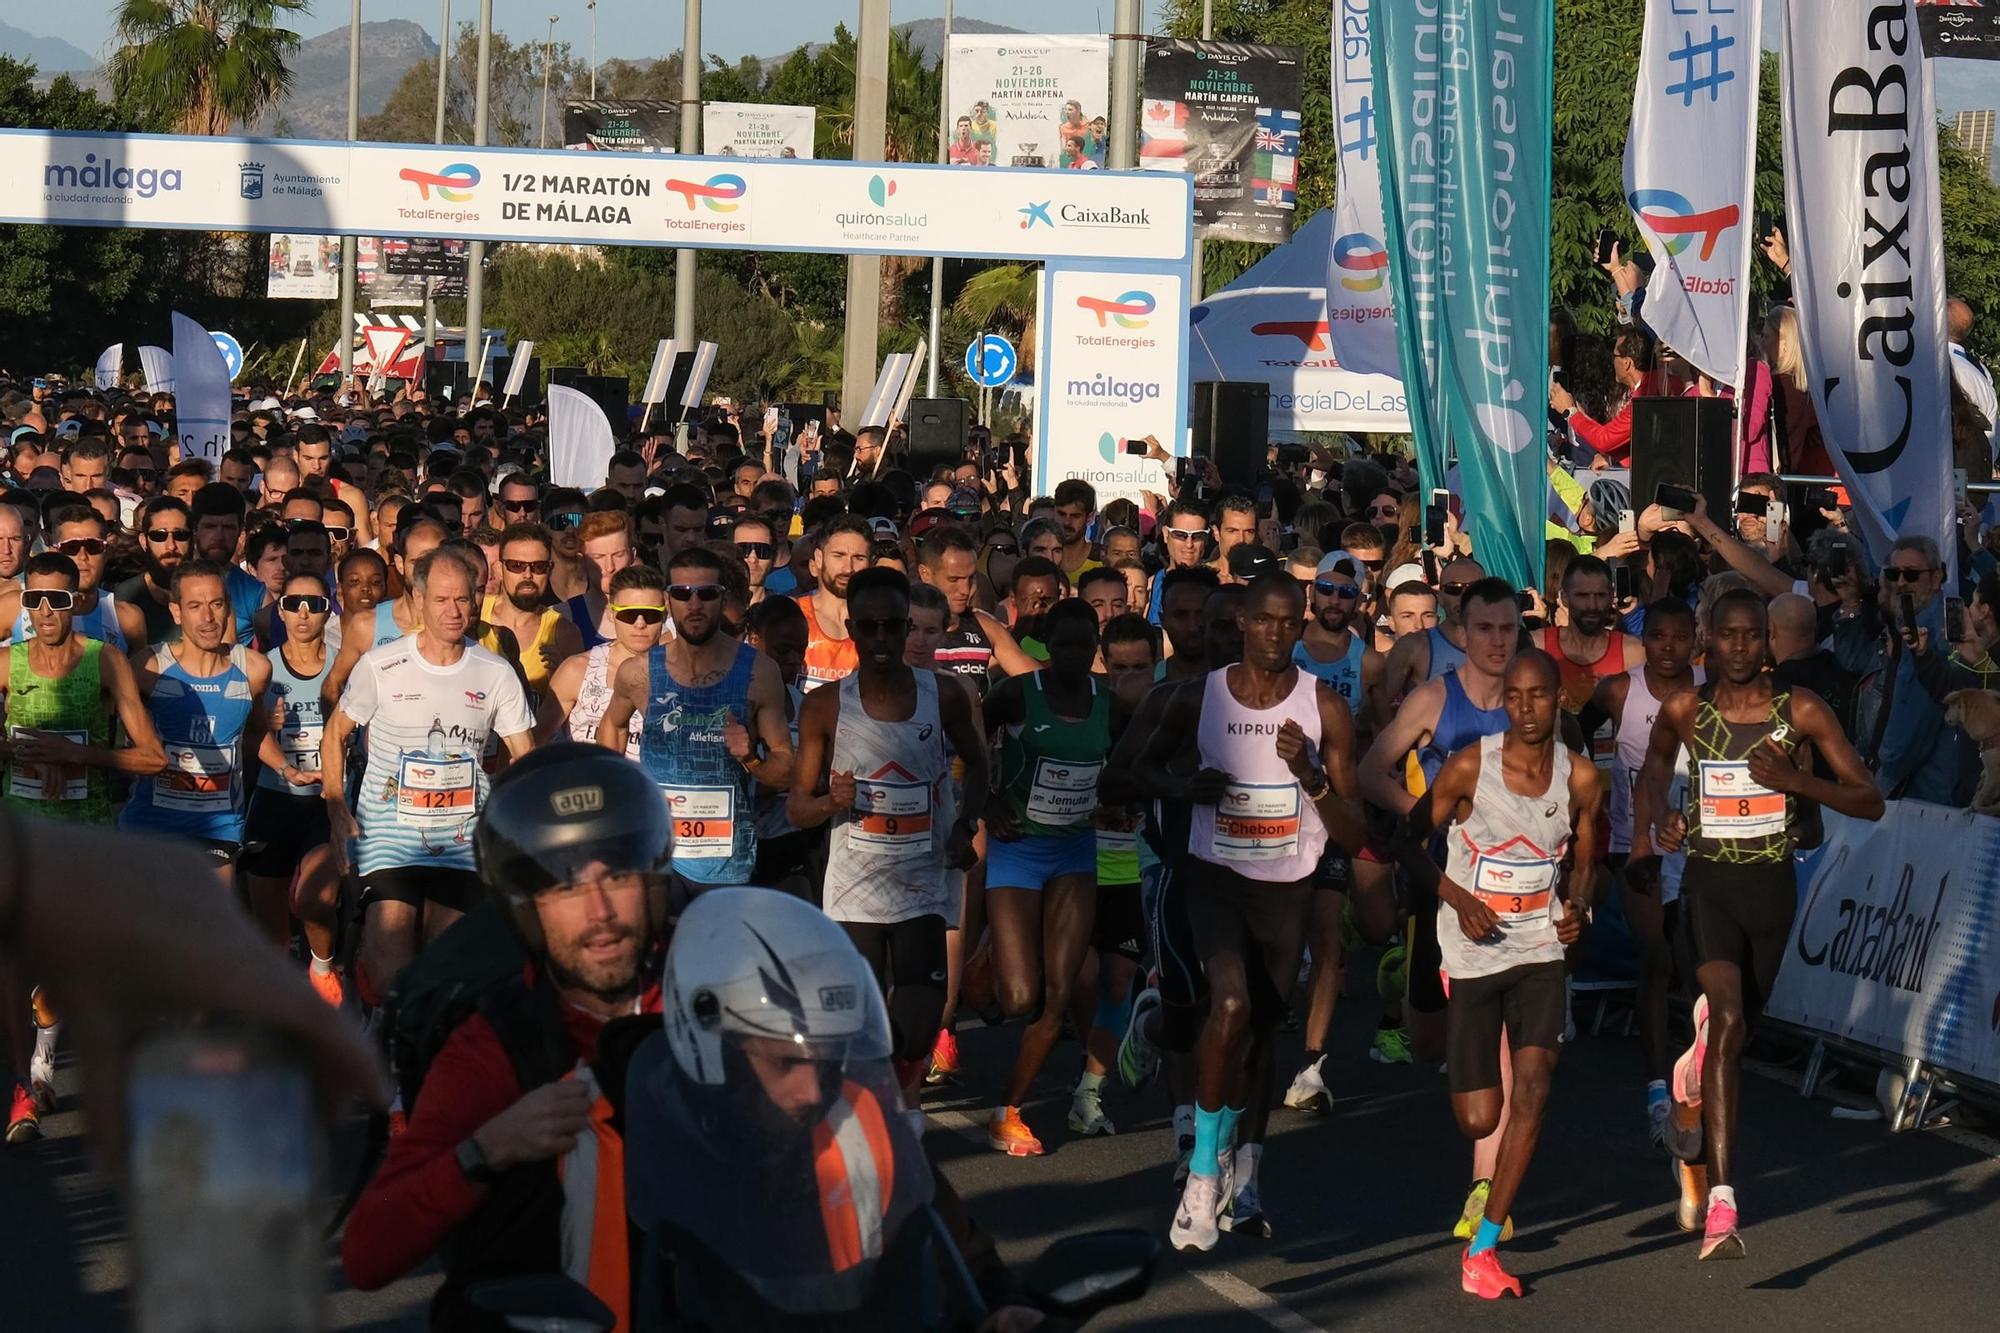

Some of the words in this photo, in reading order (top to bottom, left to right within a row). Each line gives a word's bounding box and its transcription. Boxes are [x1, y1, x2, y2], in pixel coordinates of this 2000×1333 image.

[1207, 53, 1231, 61] DAVIS
[1231, 54, 1249, 62] CUP
[1012, 65, 1042, 76] 21-26
[1207, 69, 1238, 80] 21-26
[995, 78, 1059, 89] NOVIEMBRE
[1190, 79, 1254, 93] NOVIEMBRE
[991, 89, 1023, 99] MARTÍN
[1025, 90, 1064, 98] CARPENA
[1184, 91, 1217, 102] MARTÍN
[1220, 93, 1260, 105] CARPENA
[607, 120, 629, 128] 21-26
[595, 128, 641, 137] NOVIEMBRE
[736, 130, 782, 138] NOVIEMBRE
[273, 172, 341, 186] Ayuntamiento
[503, 173, 536, 193] 1/2
[542, 173, 651, 197] MARATÓN
[272, 185, 285, 195] de
[287, 184, 323, 197] Málaga
[55, 192, 89, 203] ciudad
[91, 194, 134, 204] redonda
[398, 208, 480, 223] TotalEnergies
[502, 201, 530, 221] DE
[536, 200, 632, 225] MÁLAGA
[835, 209, 927, 228] quirónsalud
[1060, 204, 1150, 226] CaixaBank
[665, 218, 746, 233] TotalEnergies
[843, 231, 887, 242] Healthcare
[889, 232, 920, 243] Partner
[1075, 335, 1156, 349] TotalEnergies
[1258, 359, 1340, 368] TotalE
[1074, 399, 1098, 407] ciudad
[1099, 400, 1128, 408] redonda
[1269, 389, 1408, 413] nergíaDeLas
[423, 791, 455, 808] 121
[1738, 799, 1750, 816] 8
[681, 821, 705, 838] 30
[886, 818, 898, 835] 9
[1230, 823, 1285, 835] Chebon
[1252, 839, 1262, 848] 12
[1510, 897, 1522, 913] 3
[1798, 844, 1951, 994] CaixaBank
